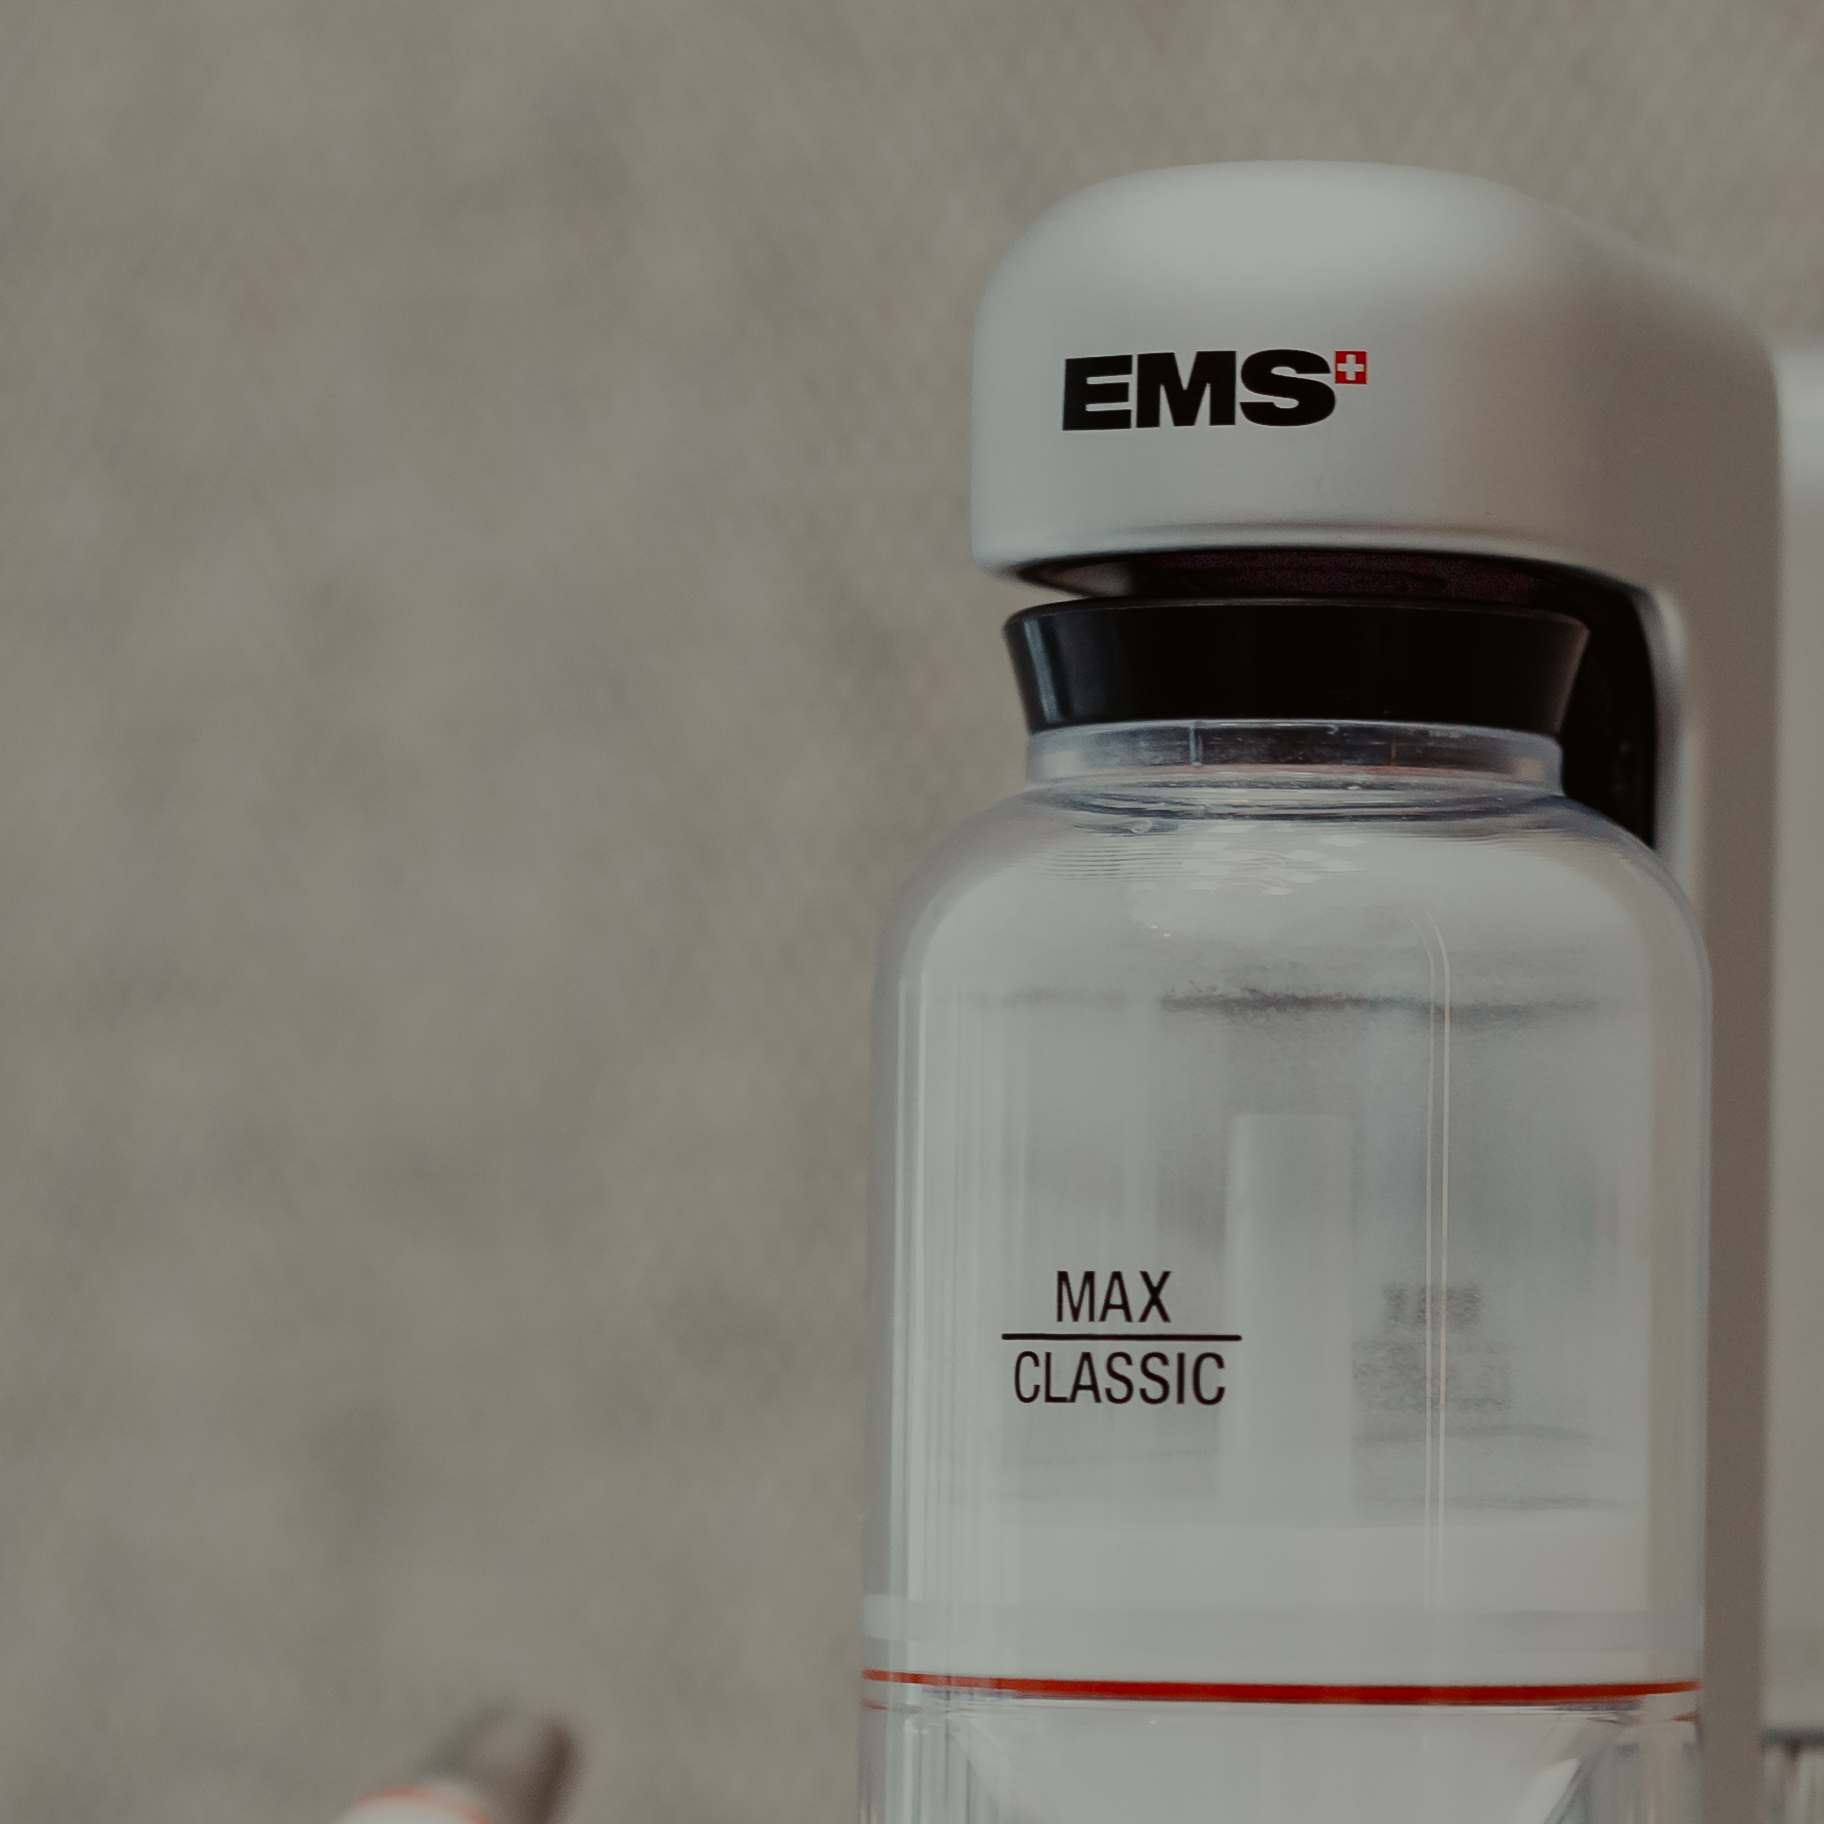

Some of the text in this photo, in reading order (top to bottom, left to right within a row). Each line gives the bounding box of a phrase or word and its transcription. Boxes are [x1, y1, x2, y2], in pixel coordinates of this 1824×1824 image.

[1062, 348, 1337, 431] EMS
[1055, 1270, 1172, 1323] MAX
[1013, 1350, 1226, 1406] CLASSIC
